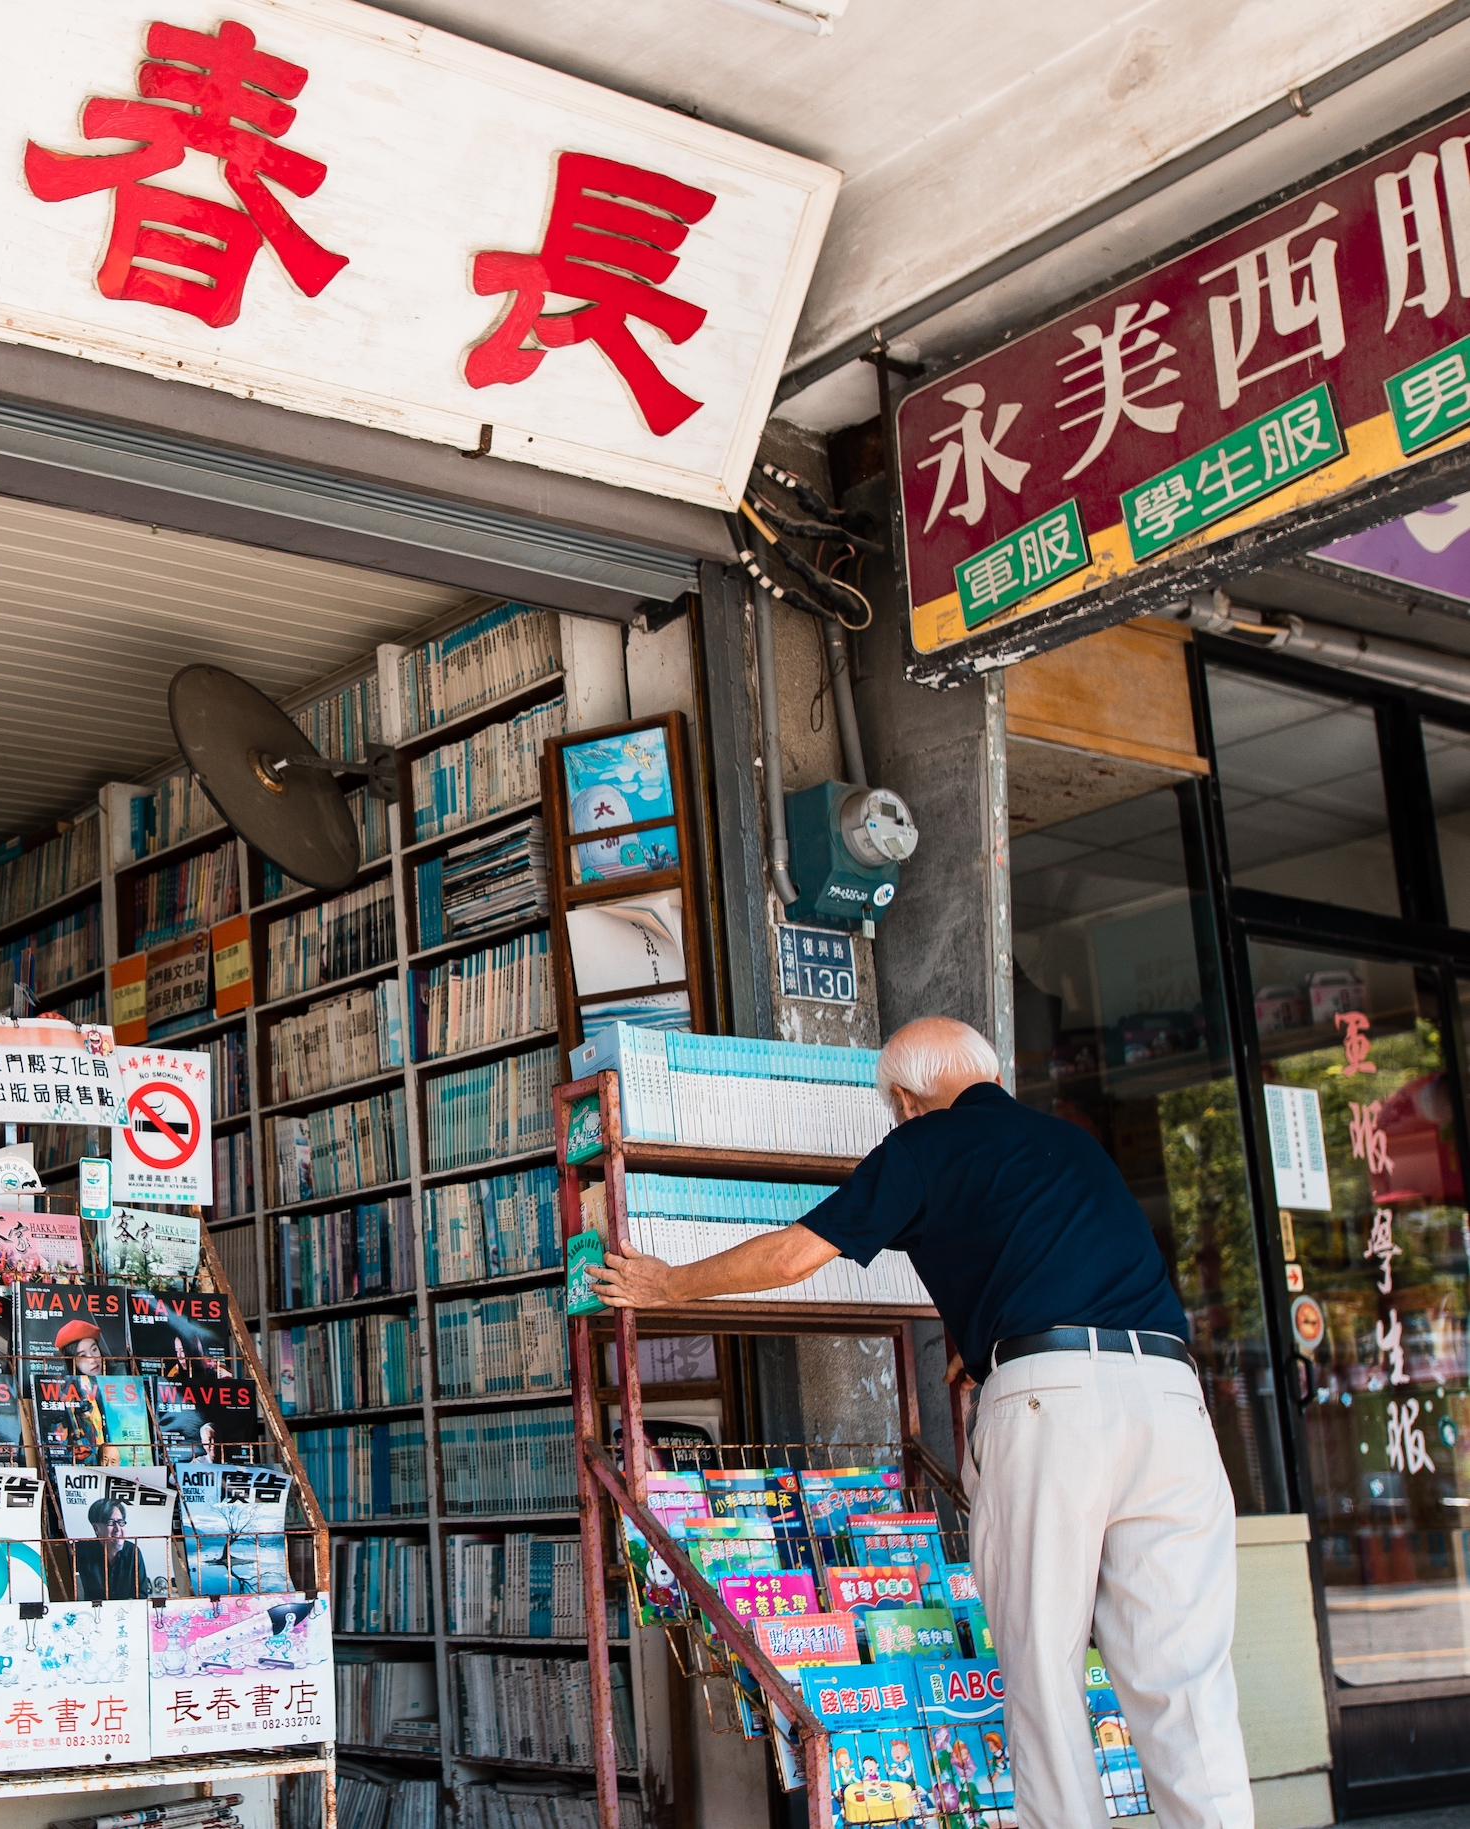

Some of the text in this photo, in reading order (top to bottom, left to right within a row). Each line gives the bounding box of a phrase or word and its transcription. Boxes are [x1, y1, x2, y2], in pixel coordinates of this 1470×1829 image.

[1134, 399, 1332, 541] 學生服
[962, 513, 1082, 611] 軍服
[802, 936, 844, 960] 復興路
[804, 967, 853, 1000] 130
[138, 1072, 183, 1083] NO SMOKING
[30, 1223, 57, 1234] HAKKA
[155, 1224, 180, 1236] HAKKA
[26, 1292, 119, 1313] WAVES
[131, 1297, 221, 1319] WAVES
[40, 1383, 137, 1403] WAVES
[159, 1386, 250, 1406] WAVES
[65, 1474, 98, 1490] Adm
[182, 1471, 215, 1487] Adm
[220, 1470, 287, 1504] 廣告
[786, 1476, 794, 1488] 2
[889, 1474, 898, 1485] 3
[768, 1625, 847, 1657] 數學習作
[876, 1626, 917, 1652] 數學
[949, 1671, 1004, 1701] ABC
[166, 1680, 319, 1724] 長春書店
[820, 1684, 908, 1715] 錢幣列車
[262, 1716, 322, 1730] 082-332702
[66, 1734, 131, 1747] 082-332702
